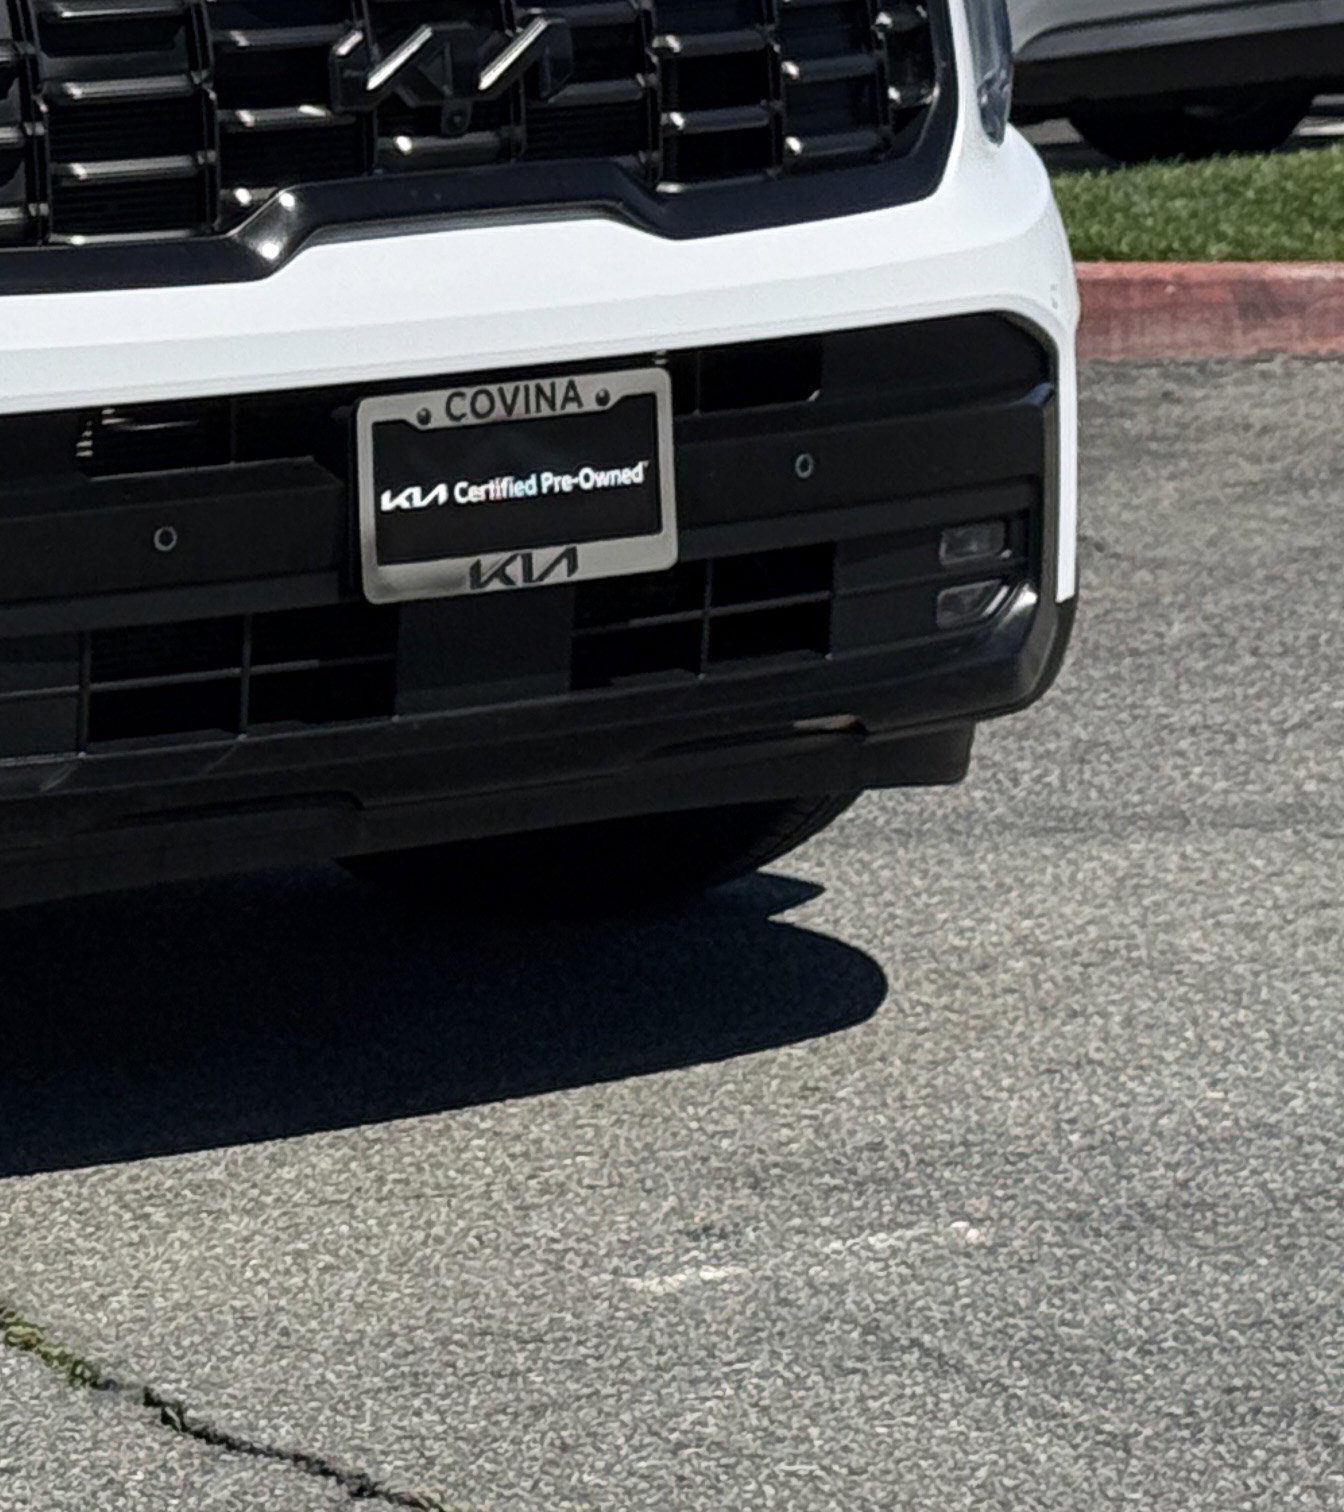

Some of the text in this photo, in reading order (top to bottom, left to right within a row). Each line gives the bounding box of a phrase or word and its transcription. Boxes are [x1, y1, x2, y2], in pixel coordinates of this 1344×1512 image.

[445, 379, 583, 423] COVINA
[380, 461, 646, 512] KIA Certified Pre-Owned
[468, 545, 579, 590] KIA
